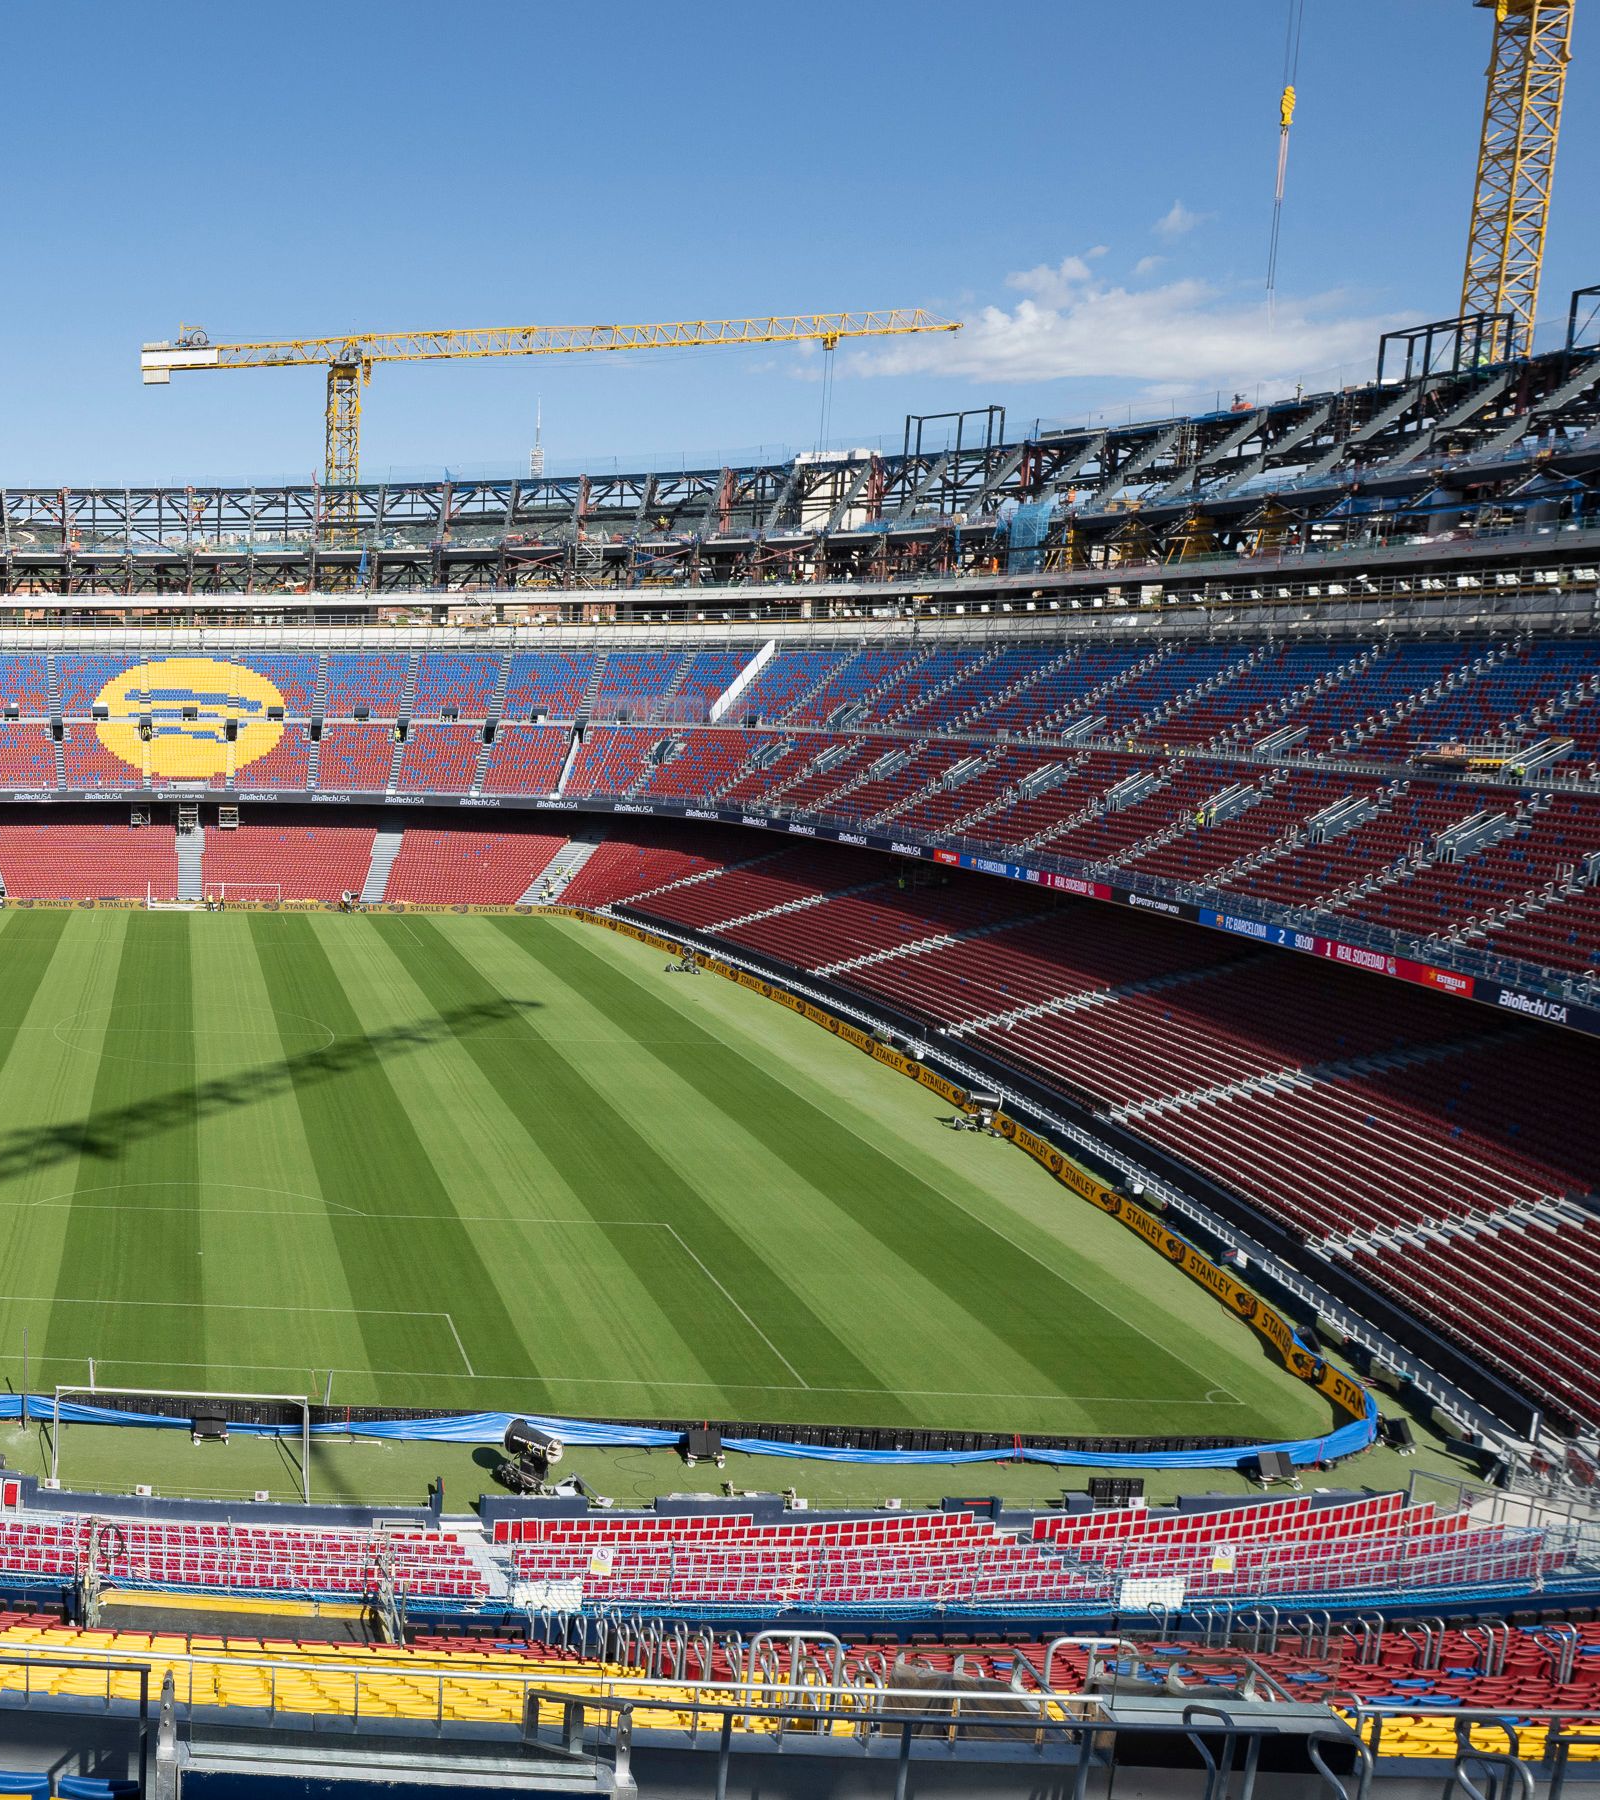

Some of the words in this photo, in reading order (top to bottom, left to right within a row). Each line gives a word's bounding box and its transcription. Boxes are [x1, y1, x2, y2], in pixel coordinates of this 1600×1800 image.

[38, 900, 73, 908] STANLEY
[99, 901, 134, 909] STANLEY
[284, 903, 320, 911] STANLEY
[537, 907, 573, 915] STANLEY
[1135, 896, 1154, 908] SPOTIFY
[1154, 901, 1168, 911] CAMP
[1168, 904, 1179, 914] NOU
[585, 915, 607, 926] STANLEY
[1225, 916, 1233, 929] FC
[1233, 918, 1266, 939] BARCELONA
[1278, 930, 1285, 944] 2
[1295, 934, 1314, 951] 90:00
[1325, 942, 1331, 957] 1
[1336, 945, 1351, 961] REAL
[1352, 948, 1385, 970] SOCIEDAD
[740, 974, 761, 990] STANLEY
[1436, 974, 1466, 990] ESTRELLA
[773, 990, 795, 1007] STANLEY
[1499, 989, 1568, 1024] BioTechUSA
[807, 1007, 828, 1025] STANLEY
[841, 1026, 864, 1045] STANLEY
[875, 1047, 904, 1067] STANLEY
[922, 1071, 950, 1094] STANLEY
[1019, 1131, 1049, 1160] STANLEY
[1064, 1166, 1096, 1198] STANLEY
[1126, 1208, 1164, 1243] STANLEY
[1190, 1256, 1232, 1296] STANLEY
